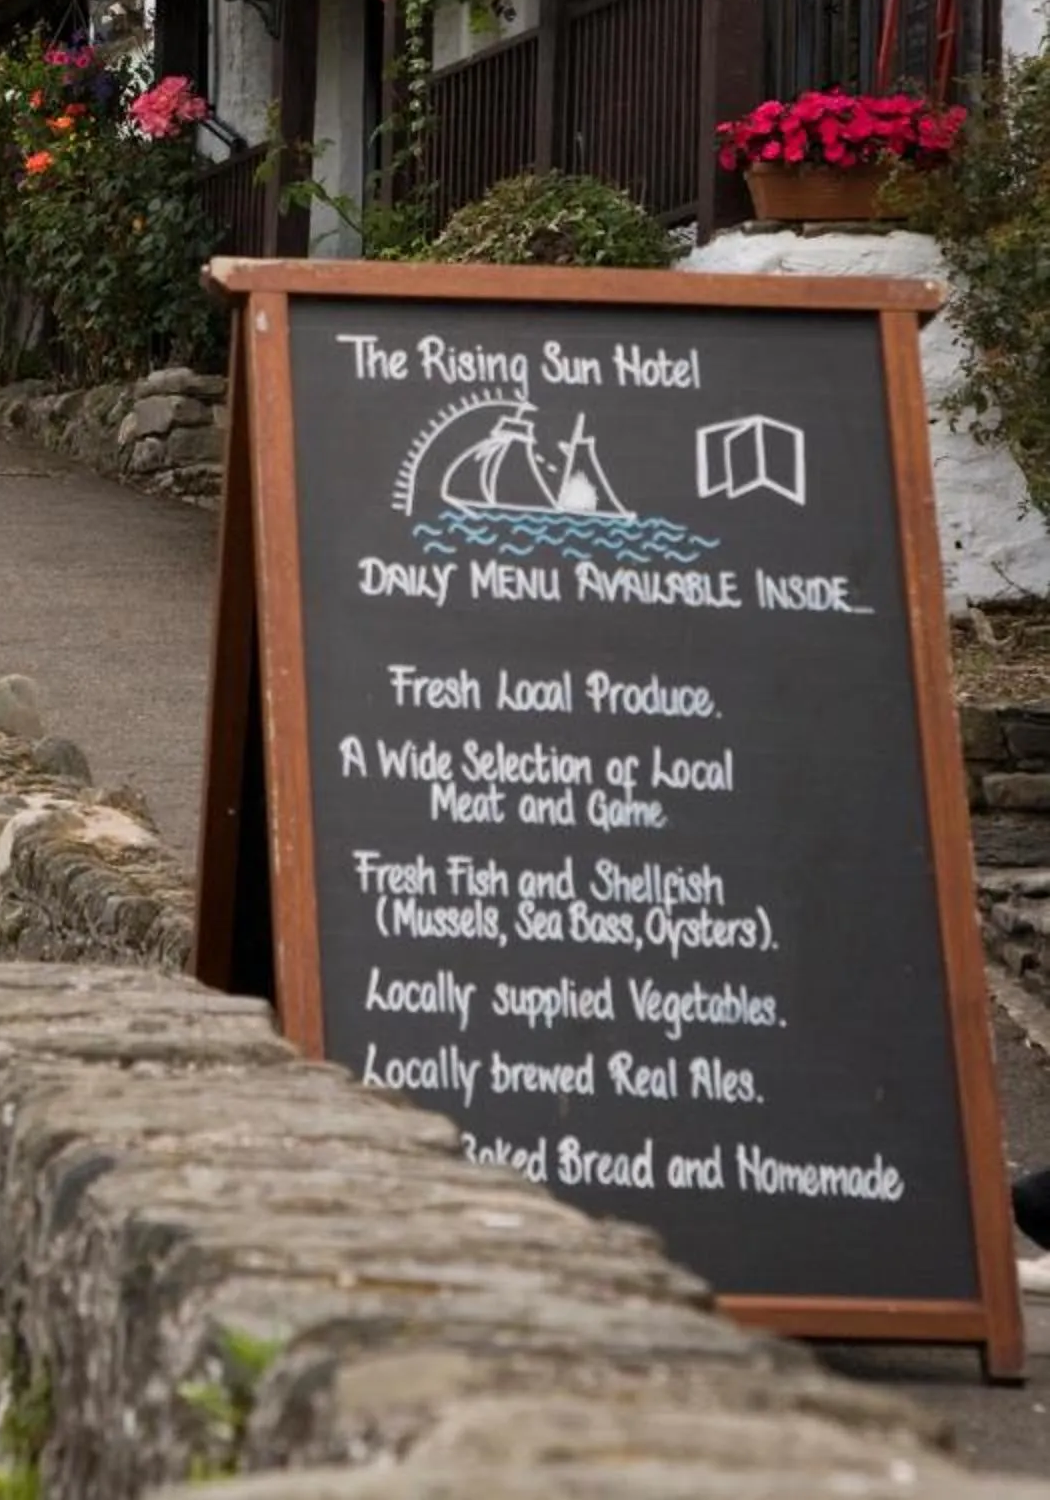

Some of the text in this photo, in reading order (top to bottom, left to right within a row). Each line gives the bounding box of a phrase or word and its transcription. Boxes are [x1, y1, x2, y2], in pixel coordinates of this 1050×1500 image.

[336, 334, 701, 400] The Rising Sun Hotel
[469, 560, 561, 600] MENU
[388, 664, 723, 720] Fresh Local Produce.
[340, 735, 734, 815] A Wide Selection of Local
[431, 782, 506, 824] Meat
[518, 788, 576, 827] and
[352, 850, 725, 911] Fresh Fish and Shellfish
[376, 896, 779, 960] (Mussels, Sea Bass, Oysters).
[365, 967, 788, 1041] Locally supplied Vegetables.
[362, 1043, 764, 1109] Locally brewed Real Ales.
[556, 1134, 654, 1189] Bread
[667, 1144, 725, 1190] and
[735, 1142, 905, 1202] Homemade
